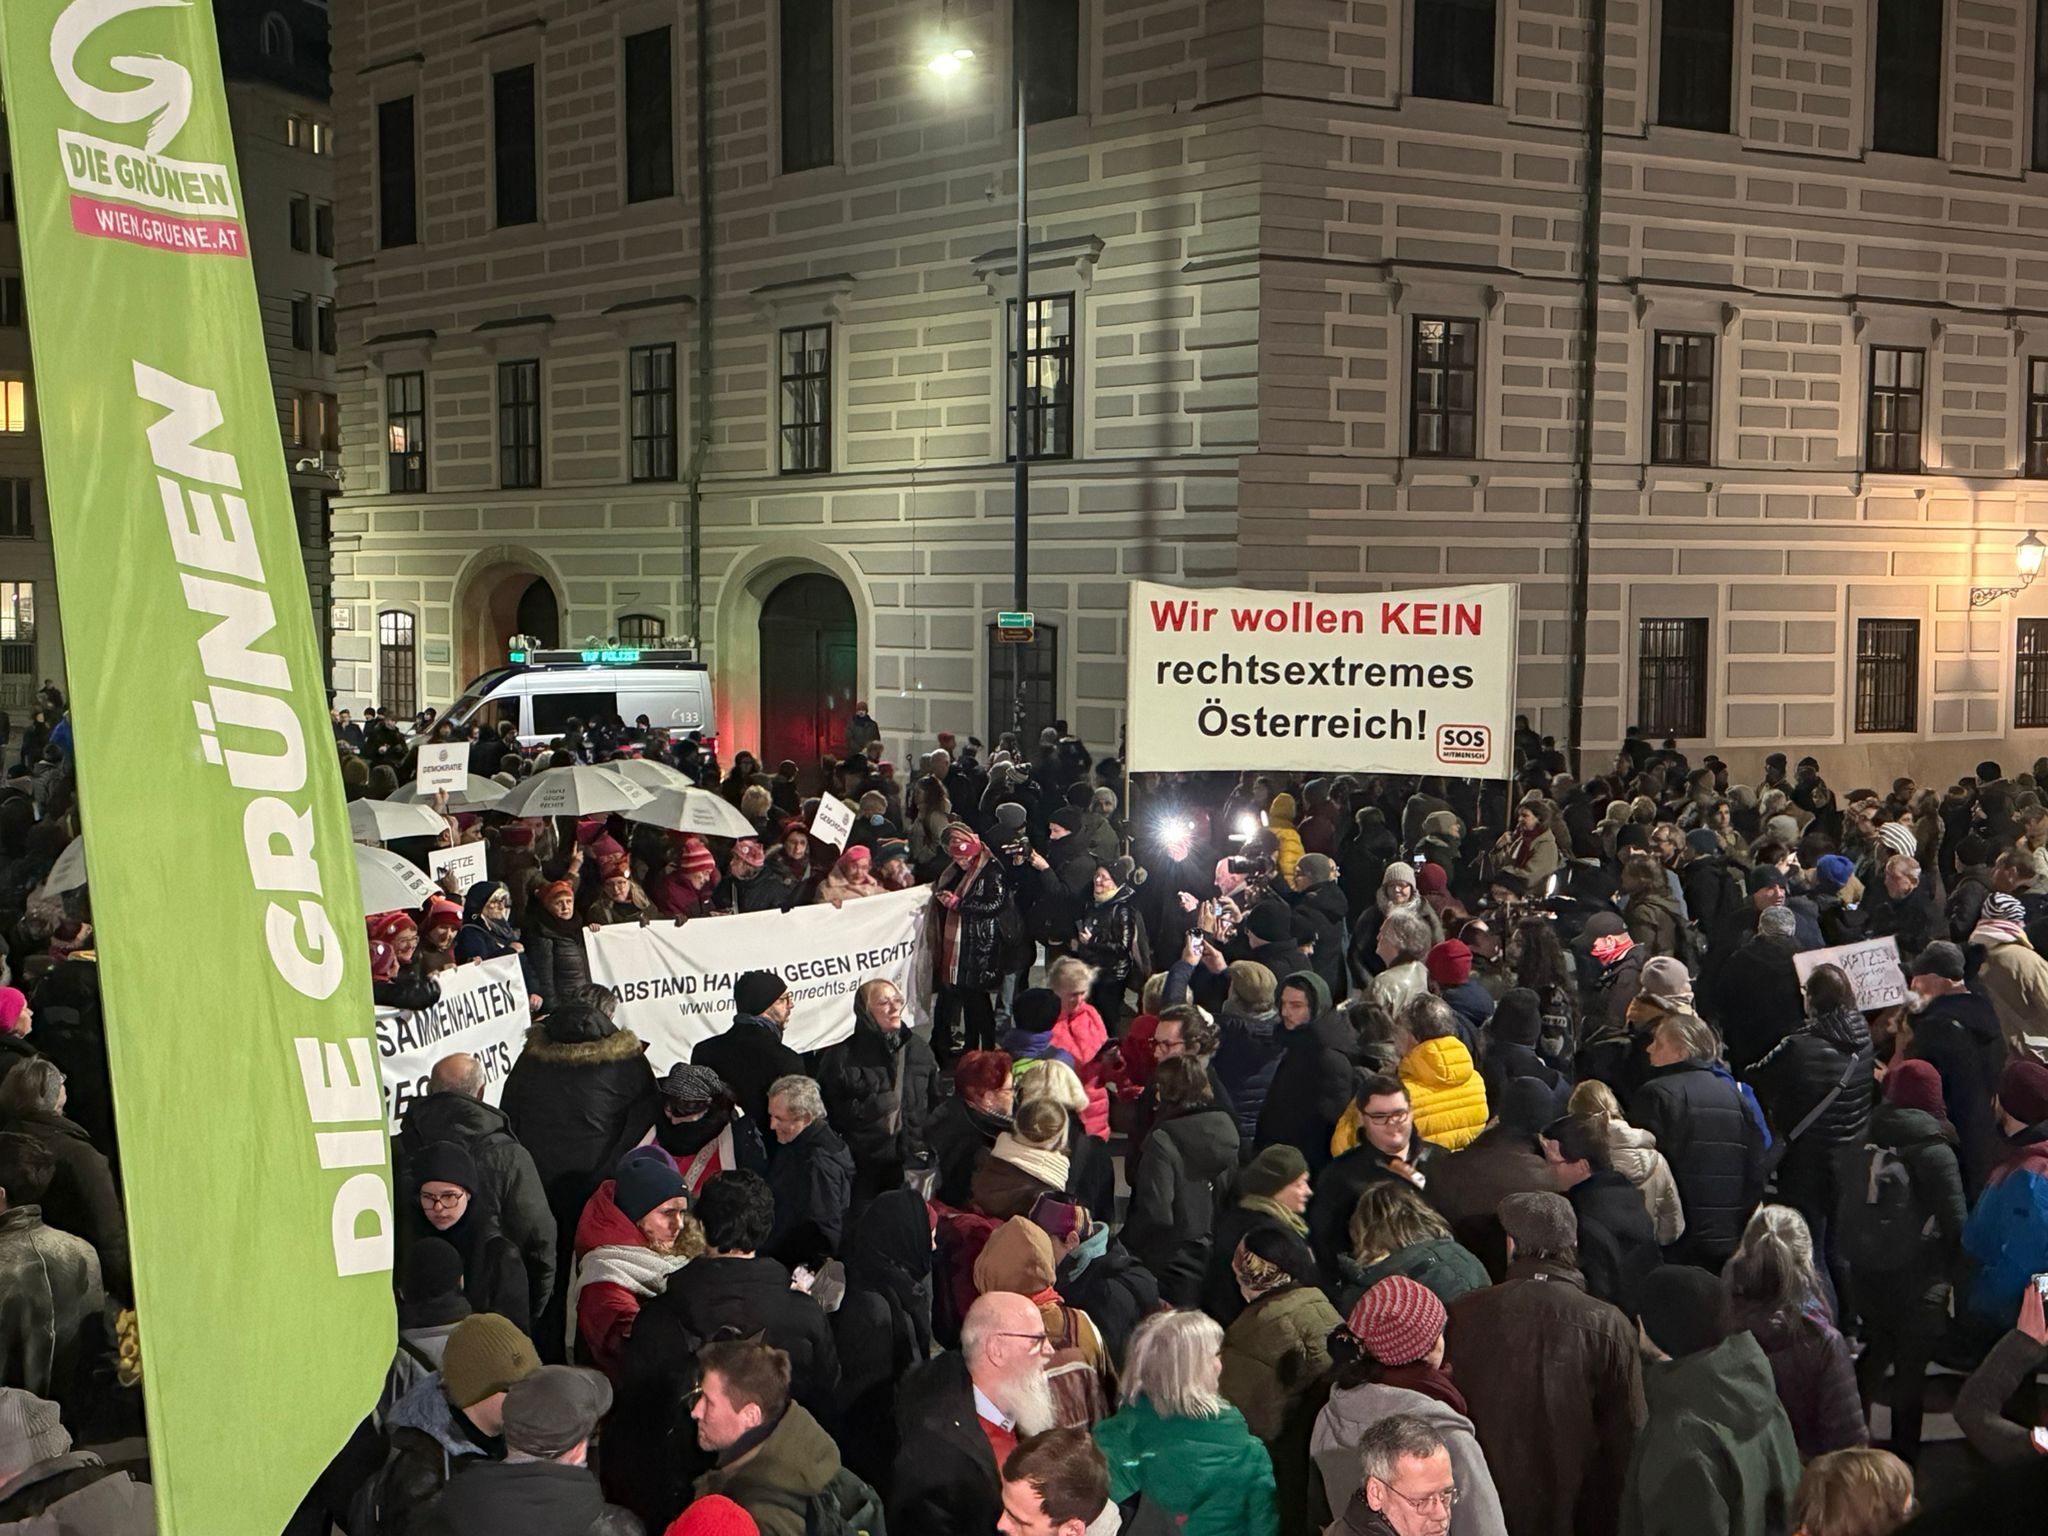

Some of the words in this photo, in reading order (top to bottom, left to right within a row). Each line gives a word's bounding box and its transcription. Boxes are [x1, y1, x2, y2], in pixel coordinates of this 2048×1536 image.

[66, 142, 113, 186] DIE
[114, 152, 229, 206] GRÜNEN
[95, 208, 238, 250] WIEN.GRUENE.AT
[1150, 600, 1218, 632] Wir
[1231, 602, 1363, 634] wollen
[1381, 602, 1482, 635] KEIN
[132, 359, 344, 1000] GRÜNEN
[1156, 653, 1474, 689] rechtsextremes
[680, 711, 698, 723] 133
[1198, 698, 1426, 740] Österreich!
[1443, 751, 1485, 759] MITMENSCH
[1444, 730, 1485, 747] SOS
[423, 763, 463, 774] DEMOKRATIE
[444, 855, 474, 871] HETZE
[611, 976, 697, 1003] ABSTAND
[784, 955, 851, 982] GEGEN
[856, 940, 916, 971] RECHTS
[376, 980, 516, 1057] SAMMENHALTEN
[294, 1036, 394, 1278] DIE
